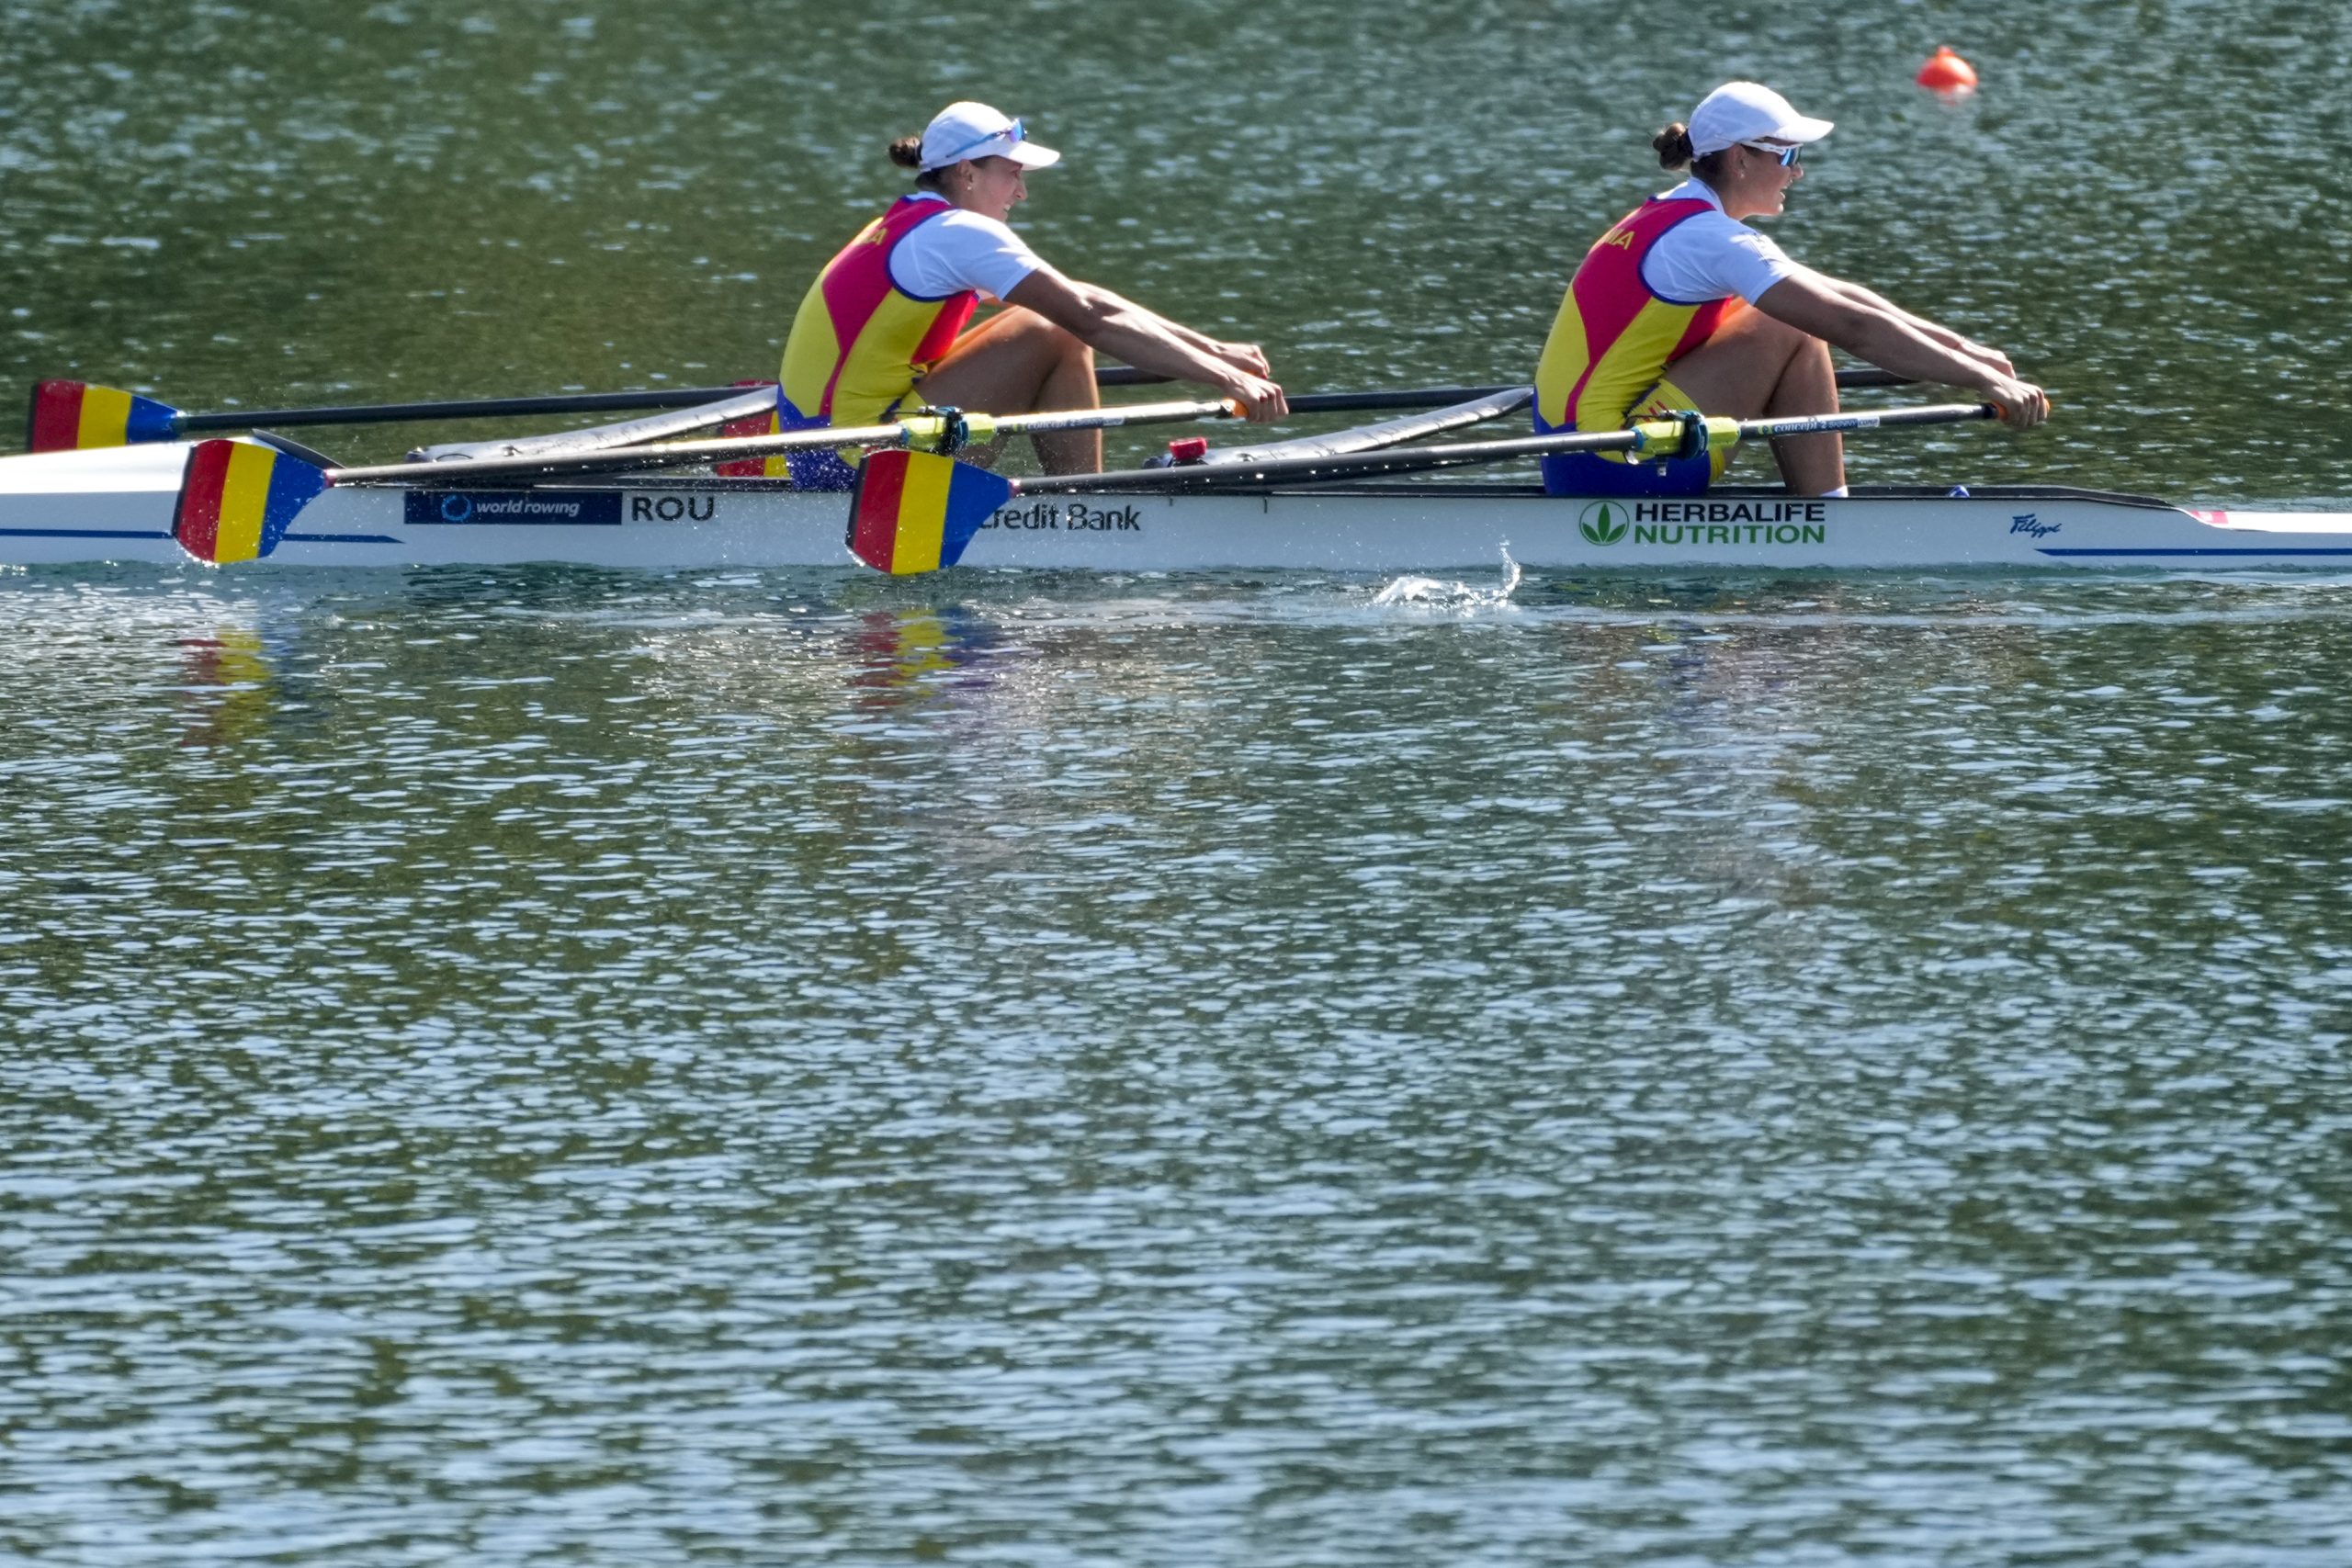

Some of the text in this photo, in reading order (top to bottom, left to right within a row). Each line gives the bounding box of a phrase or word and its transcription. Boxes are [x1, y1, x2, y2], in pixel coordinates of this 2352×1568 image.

[1774, 421, 1817, 432] concept
[1820, 421, 1827, 429] 2
[476, 499, 580, 516] world rowing
[632, 497, 715, 521] ROU
[1068, 504, 1141, 530] Bank
[1635, 503, 1826, 523] HERBALIFE
[1634, 525, 1826, 544] NUTRITION
[2010, 513, 2063, 538] Filippi
